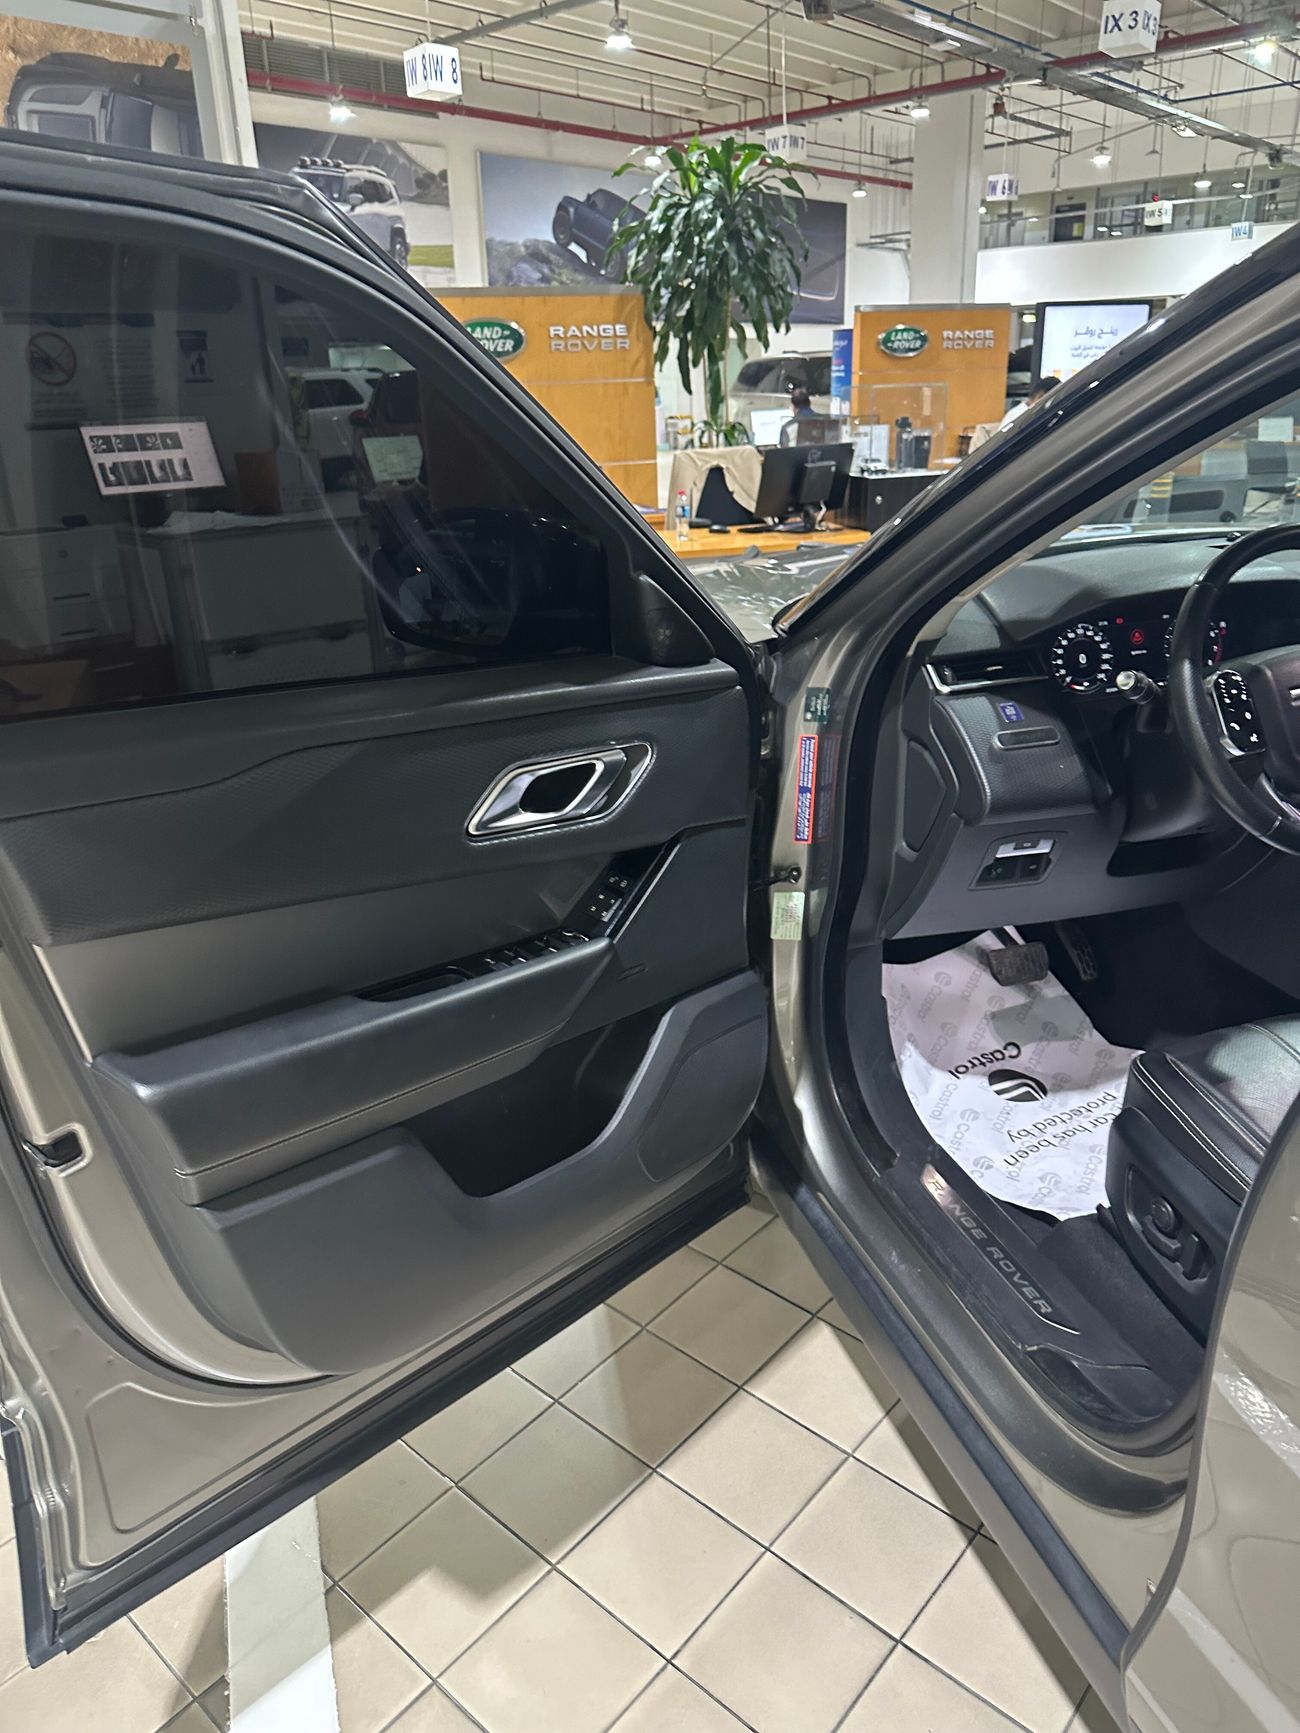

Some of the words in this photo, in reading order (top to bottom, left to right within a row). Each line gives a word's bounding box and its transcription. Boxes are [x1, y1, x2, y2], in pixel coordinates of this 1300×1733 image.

[1103, 13, 1124, 35] IX
[1128, 10, 1139, 30] 3
[451, 57, 458, 84] 8
[550, 325, 628, 338] RANGE
[943, 330, 994, 339] RANGE
[480, 339, 515, 352] OVER
[551, 339, 630, 352] ROVER
[943, 340, 994, 349] ROVER
[948, 1041, 1021, 1080] Castrol
[1032, 1091, 1117, 1134] protected
[1006, 1128, 1036, 1143] by
[1053, 1124, 1093, 1140] has
[1003, 1138, 1057, 1167] been
[929, 1180, 988, 1240] RNGE
[986, 1246, 1053, 1313] ROVER
